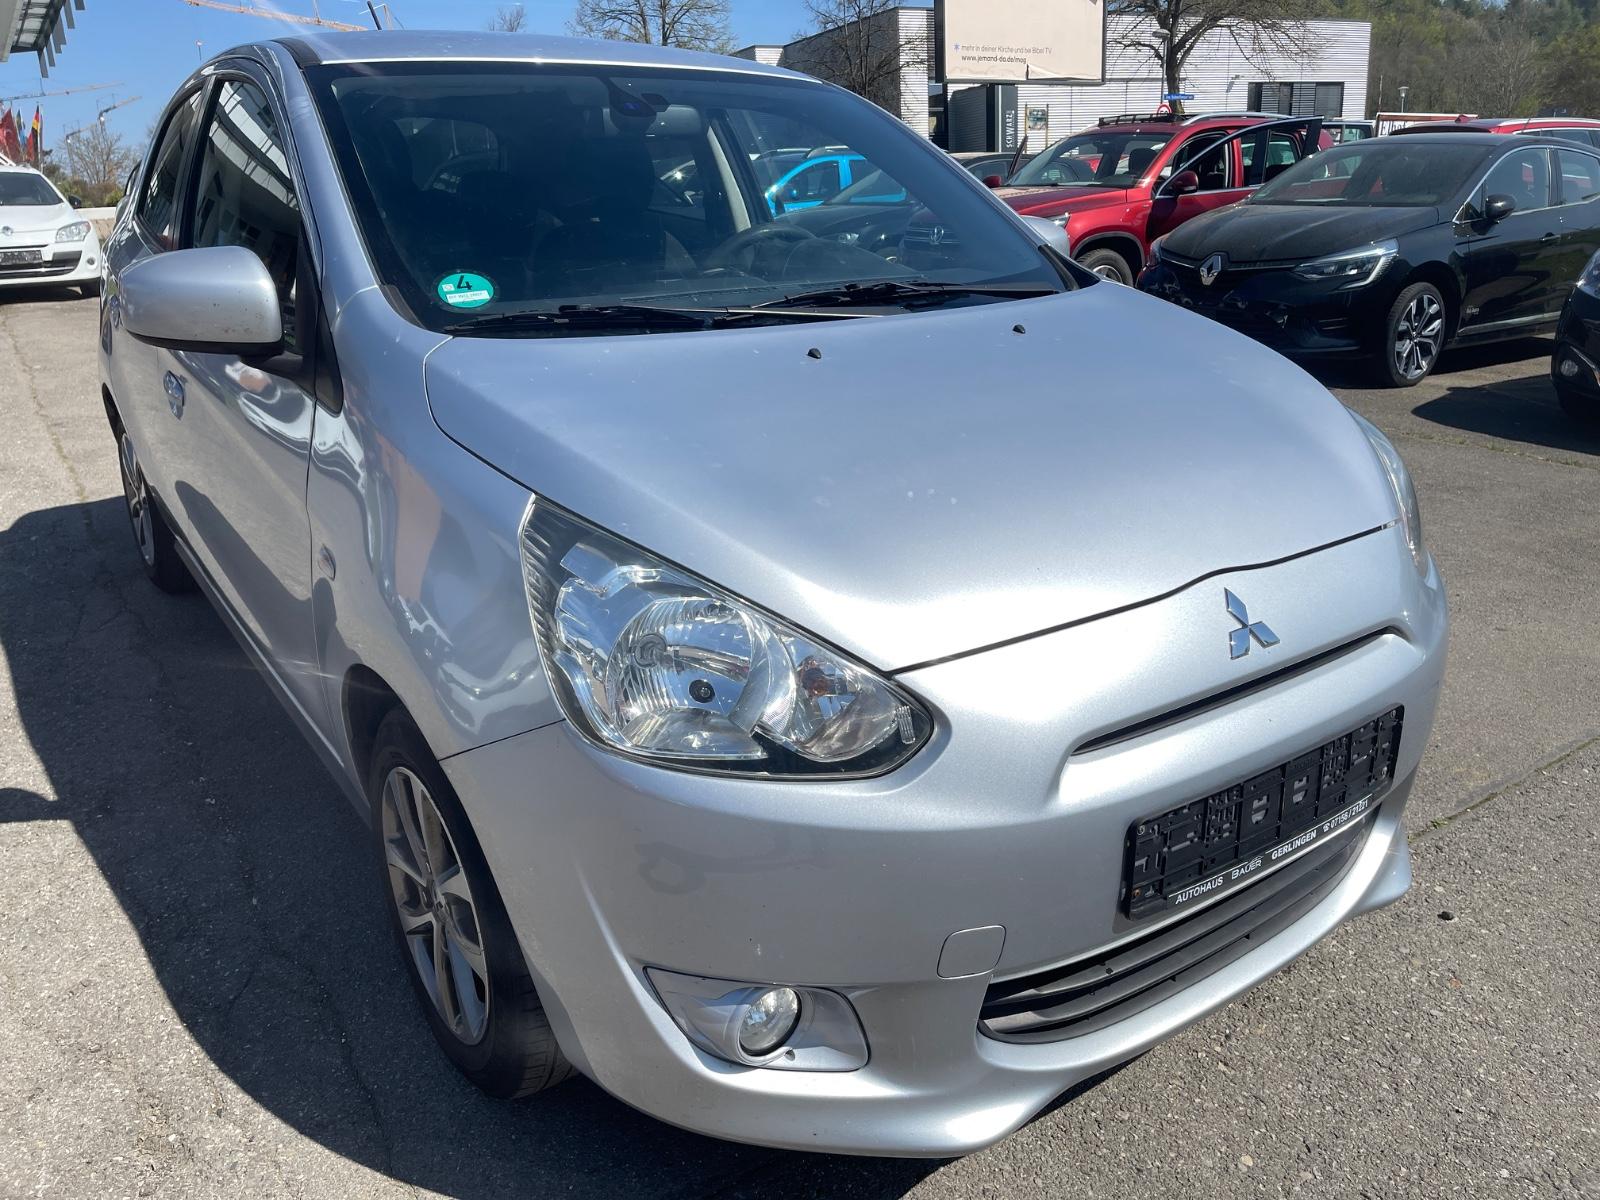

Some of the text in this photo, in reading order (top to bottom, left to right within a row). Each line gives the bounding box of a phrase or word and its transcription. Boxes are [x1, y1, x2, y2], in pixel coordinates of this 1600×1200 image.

[961, 44, 975, 52] mehr
[997, 45, 1013, 54] Kirche
[1014, 46, 1024, 54] und
[1005, 112, 1014, 148] SCHWARZ
[457, 275, 472, 290] 4
[1175, 876, 1224, 905] AUTOHAUS
[1231, 859, 1262, 880] BAUER
[1271, 829, 1317, 860] GERLINGEN
